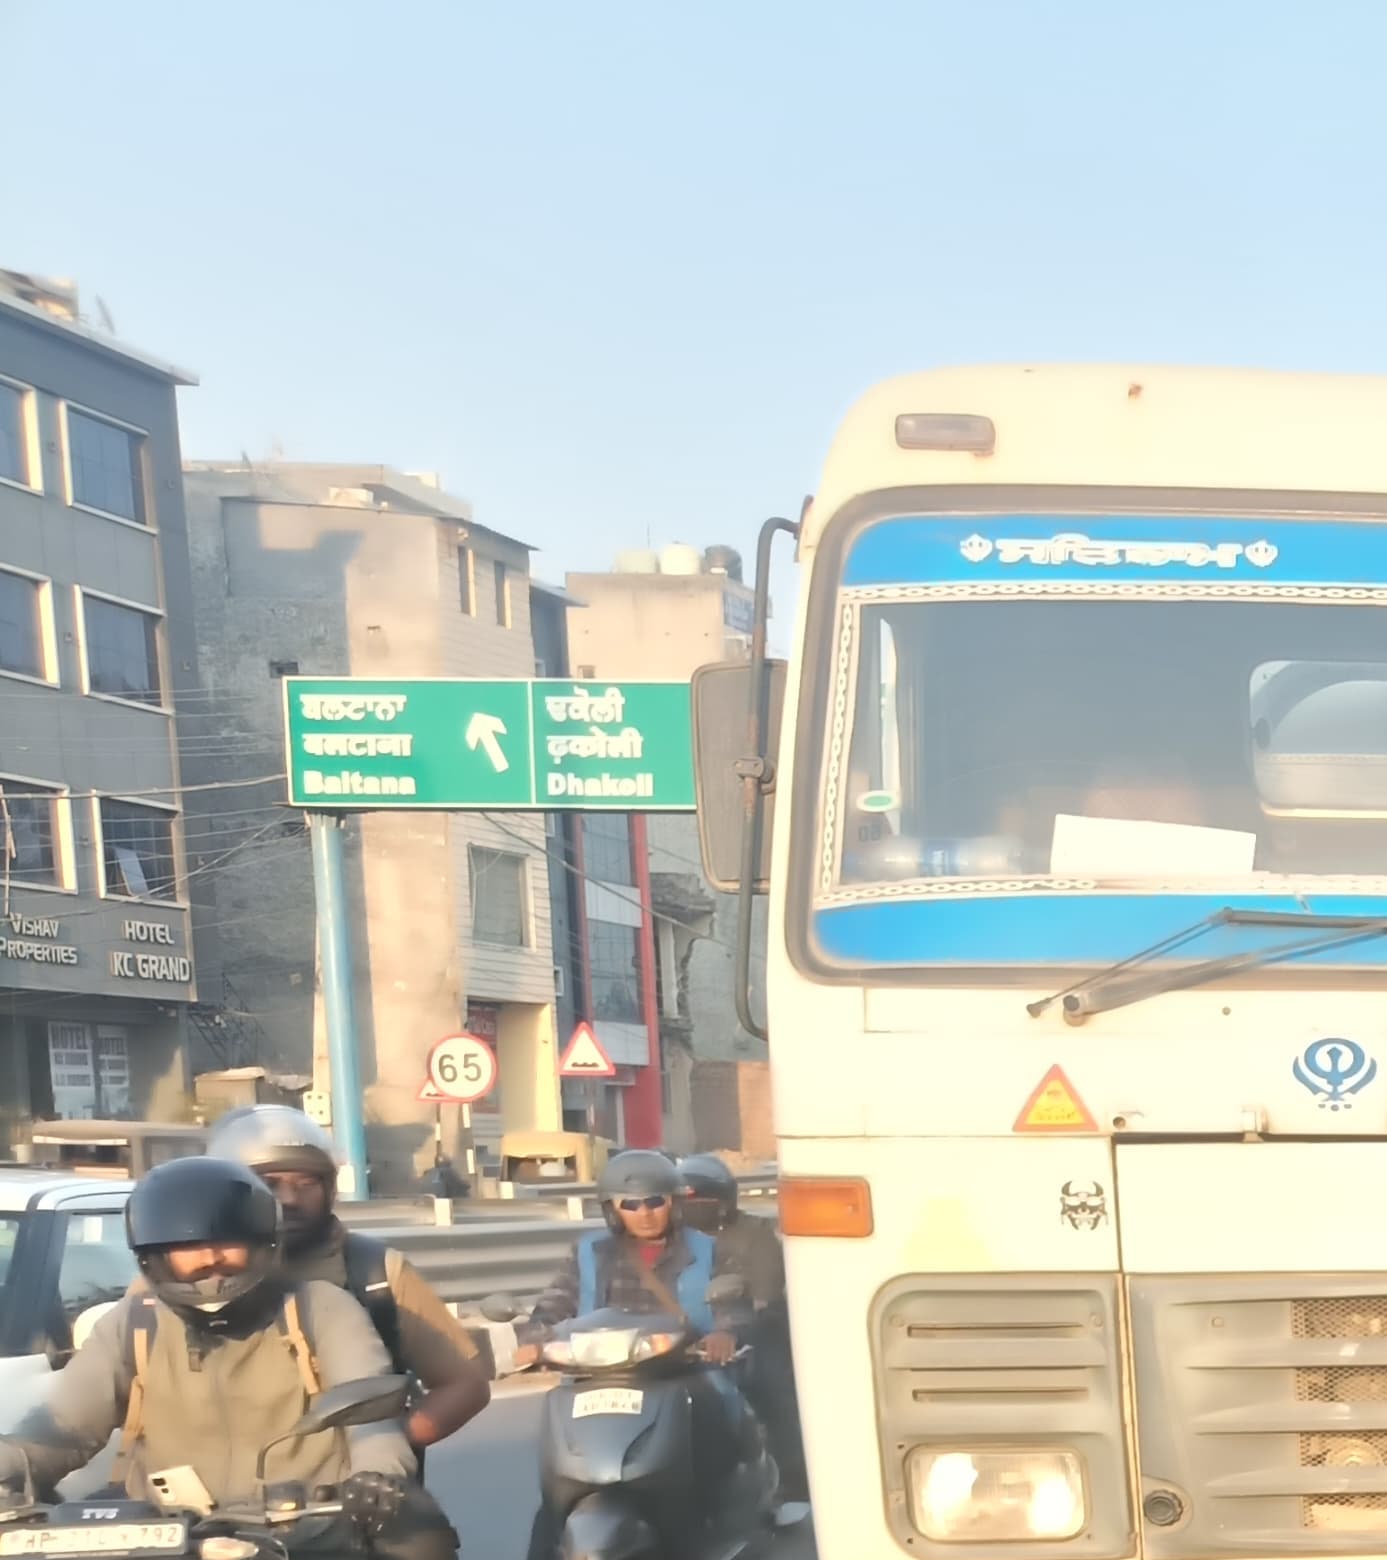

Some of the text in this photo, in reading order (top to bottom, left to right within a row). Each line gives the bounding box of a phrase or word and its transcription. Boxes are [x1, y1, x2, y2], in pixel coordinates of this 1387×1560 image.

[303, 769, 417, 795] Baltana
[547, 772, 654, 797] Dhakoli
[10, 912, 60, 938] VISHAV
[124, 919, 176, 945] HOTEL
[0, 937, 78, 965] PROPERTIES
[112, 951, 192, 982] KC GRAND
[438, 1053, 482, 1083] 65
[81, 1508, 119, 1519] TVS
